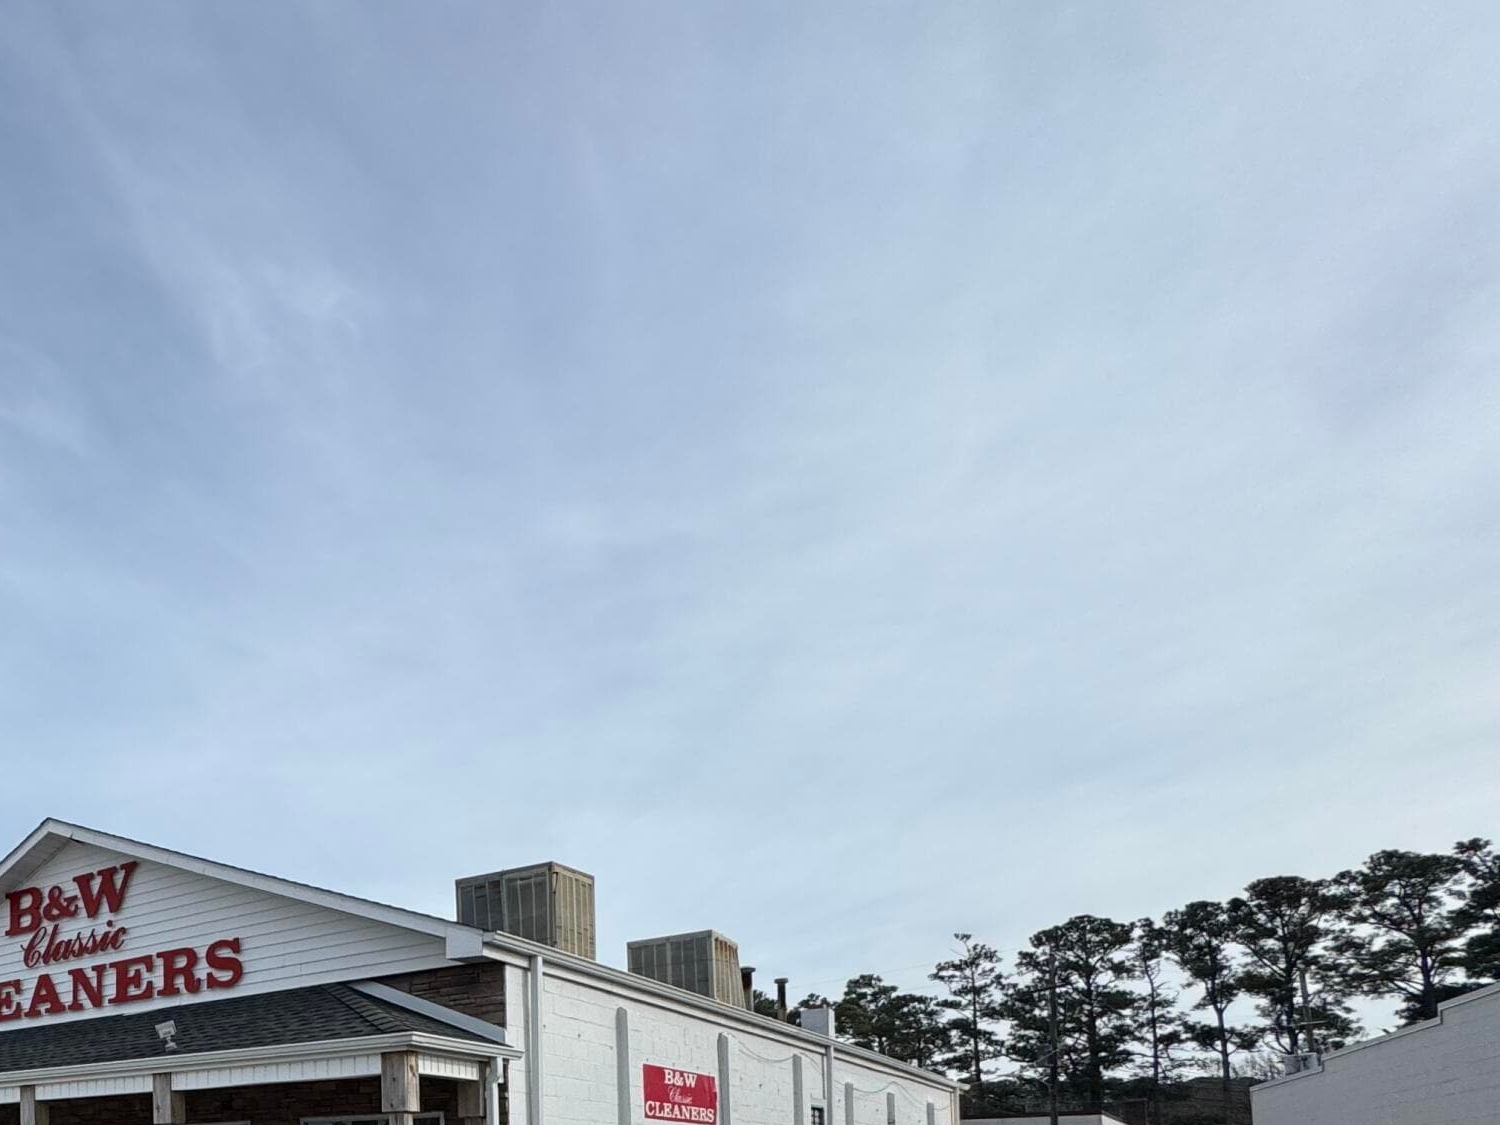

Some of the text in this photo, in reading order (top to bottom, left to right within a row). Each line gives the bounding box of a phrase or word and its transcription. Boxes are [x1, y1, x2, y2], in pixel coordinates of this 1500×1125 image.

[4, 860, 139, 937] B&W
[20, 920, 128, 969] Classic
[663, 1069, 698, 1088] B&W
[645, 1100, 715, 1123] CLEANERS
